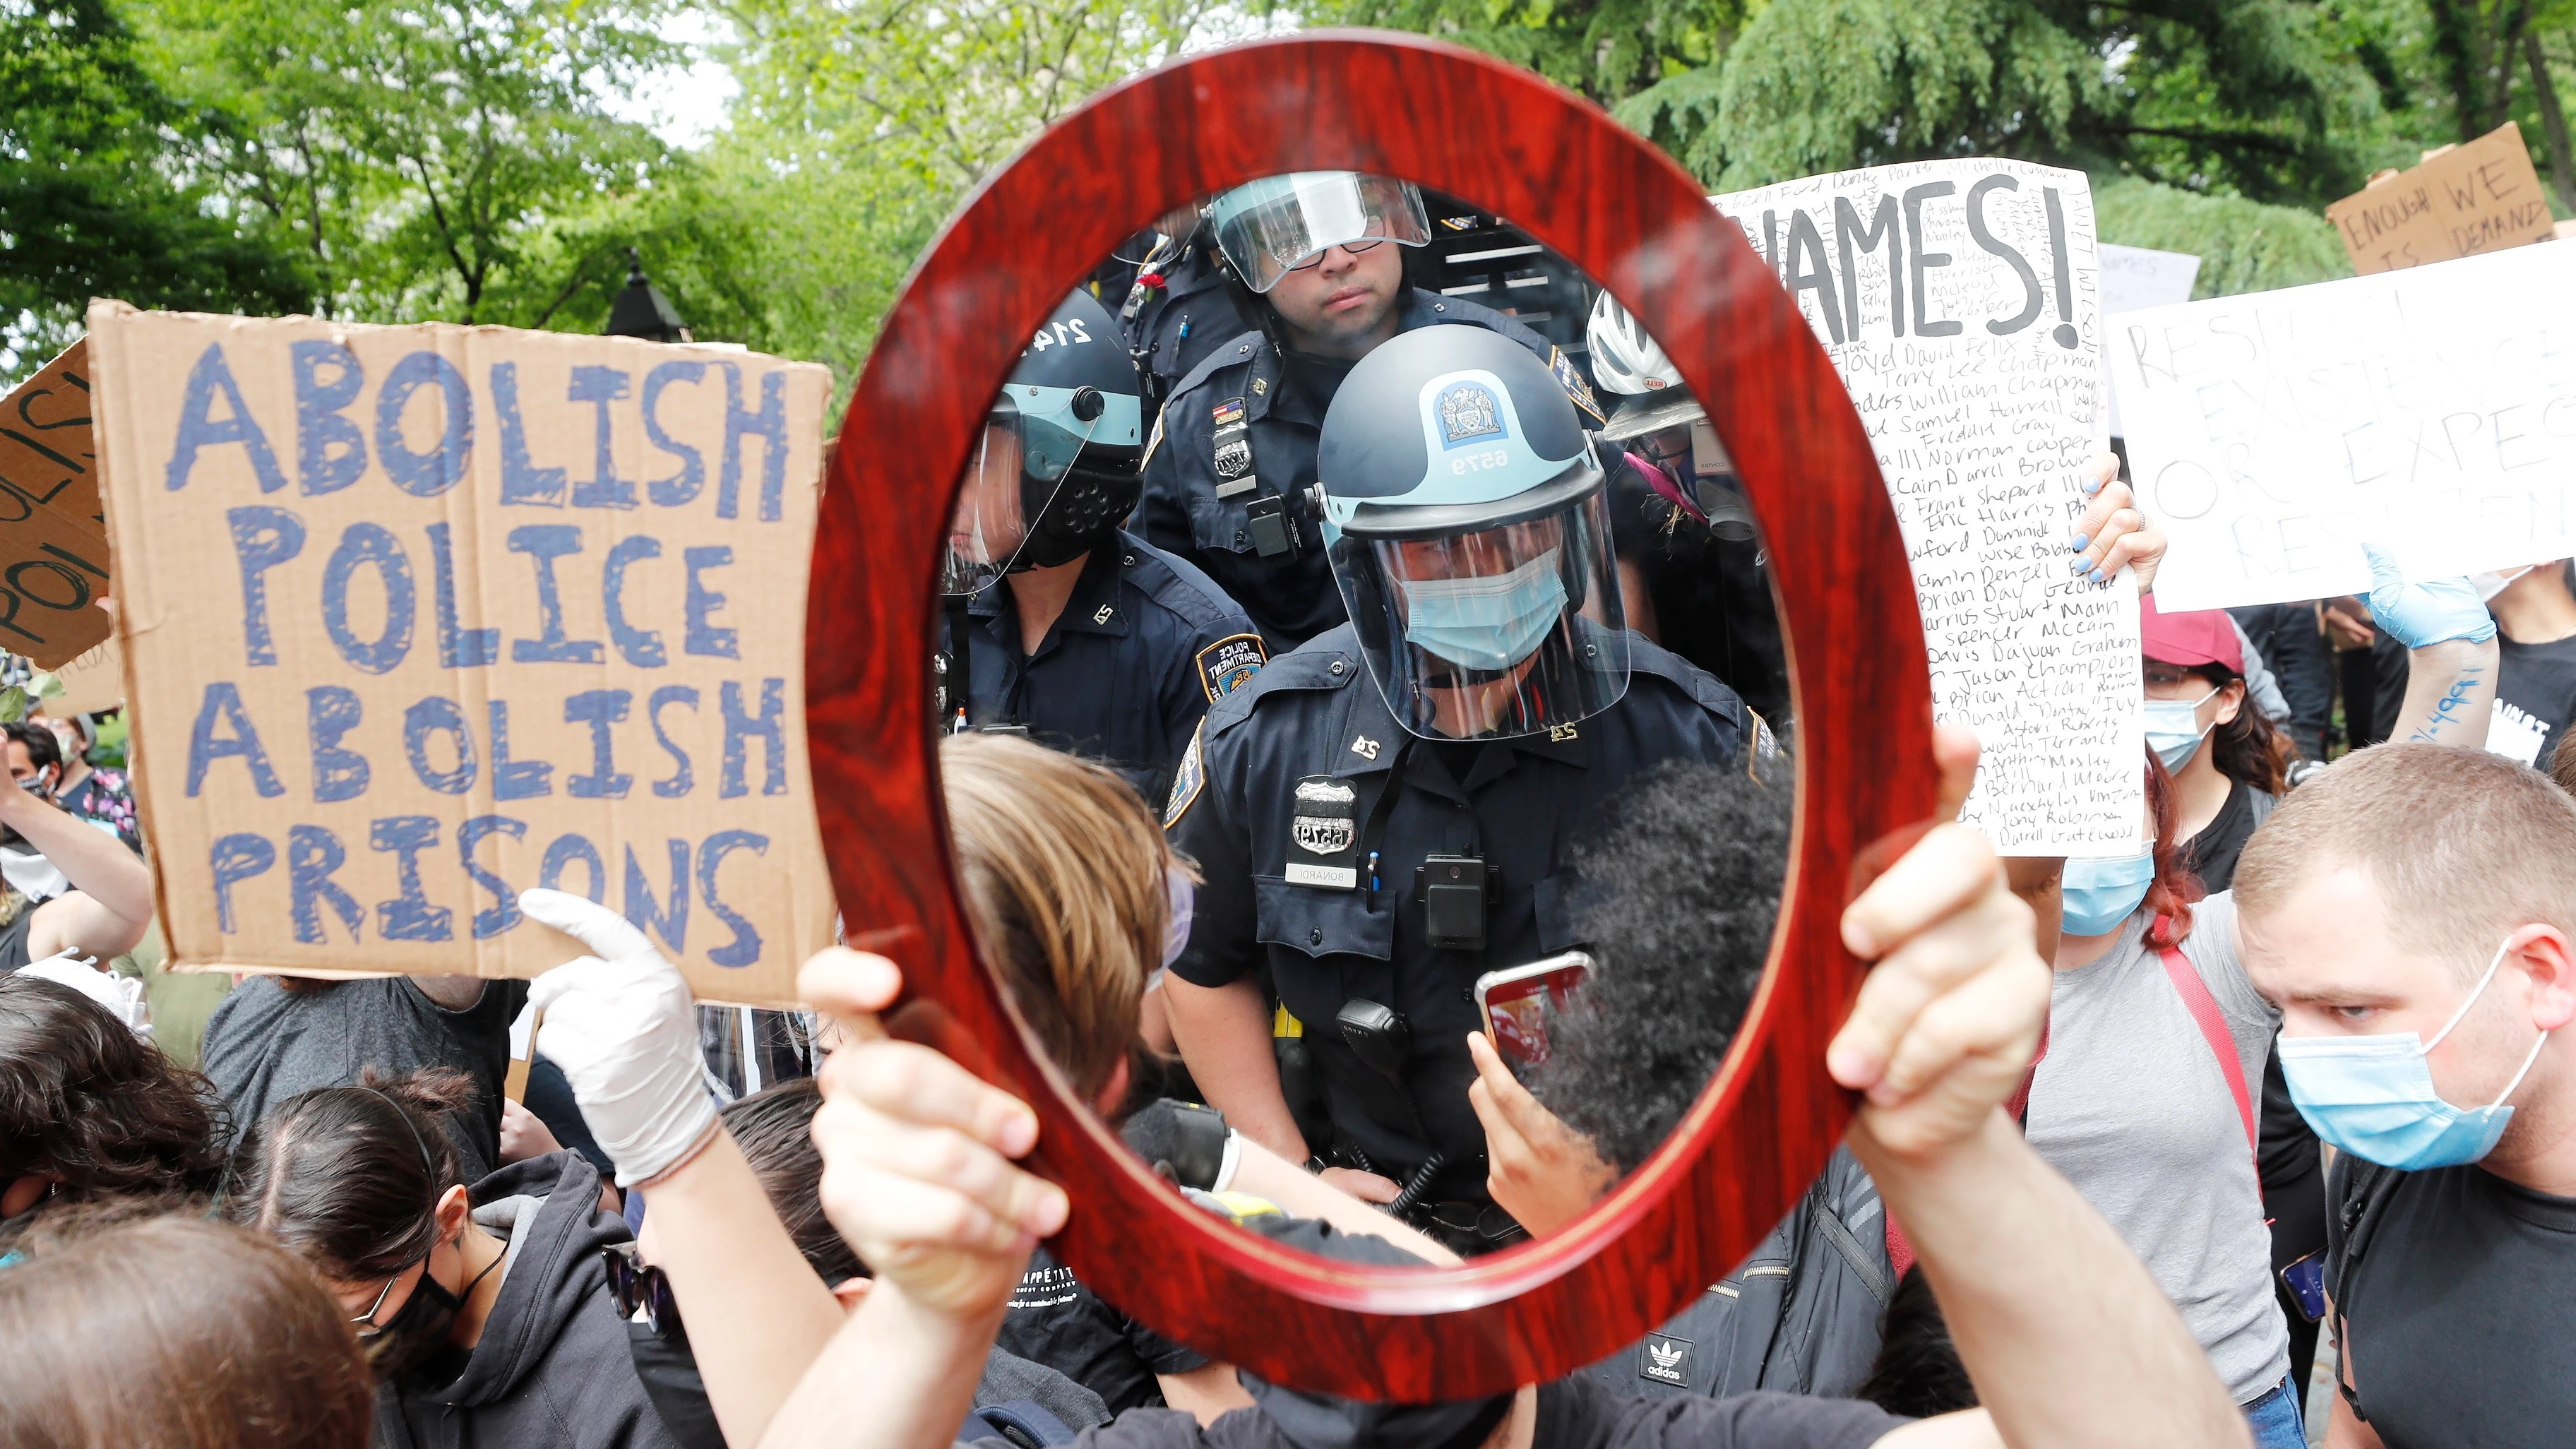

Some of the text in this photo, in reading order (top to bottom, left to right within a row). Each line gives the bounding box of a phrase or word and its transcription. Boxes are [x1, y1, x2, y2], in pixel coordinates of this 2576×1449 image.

[2444, 157, 2522, 211] WE
[2344, 186, 2431, 251] ENOUGH
[2452, 200, 2546, 255] DEMAND
[2062, 185, 2099, 354] JANET WILSON
[1905, 340, 1955, 366] David
[1966, 338, 2020, 357] Felix
[1901, 404, 1970, 434] Samuel
[1909, 383, 1998, 412] William
[166, 340, 789, 523] ABOLISH
[2155, 443, 2291, 520] OR
[1978, 502, 2055, 524] Harris
[227, 506, 741, 675] POLICE
[1921, 609, 1978, 633] arrius
[2061, 600, 2119, 620] Mann
[1928, 648, 1979, 664] Davis
[185, 677, 788, 803] ABOLISH
[210, 813, 771, 969] PRISONS
[1040, 1281, 1076, 1292] COMPANY
[1647, 1365, 1681, 1381] adidas
